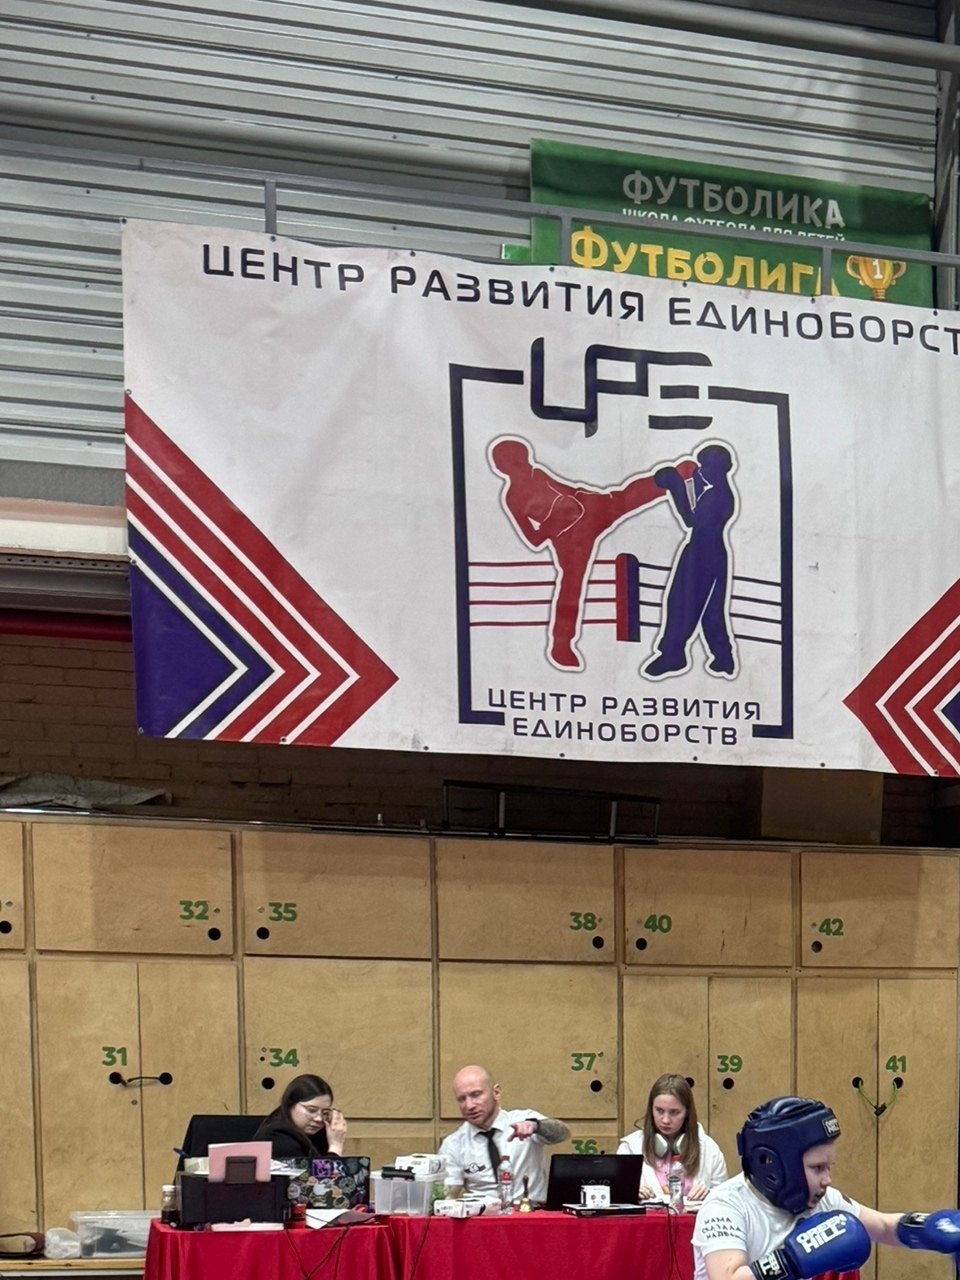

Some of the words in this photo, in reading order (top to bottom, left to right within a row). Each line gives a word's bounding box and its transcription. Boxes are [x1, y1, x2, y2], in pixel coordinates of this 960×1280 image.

[622, 169, 846, 229] ФУТБОЛИКА
[202, 243, 364, 291] ЦЕНТР
[391, 265, 645, 322] РАЗВИТИЯ
[487, 687, 587, 713] ЦЕНТР
[602, 696, 761, 721] РАЗВИТИЯ
[513, 717, 738, 746] ЕДИНОБОРСТВ
[179, 900, 209, 920] 32
[268, 902, 298, 922] 35
[569, 912, 597, 931] 38
[644, 914, 672, 933] 40
[818, 918, 844, 936] 42
[101, 1046, 128, 1066] 31
[269, 1048, 299, 1067] 34
[570, 1053, 596, 1071] 37
[717, 1055, 742, 1072] 39
[885, 1055, 907, 1072] 41
[572, 1139, 598, 1154] 36
